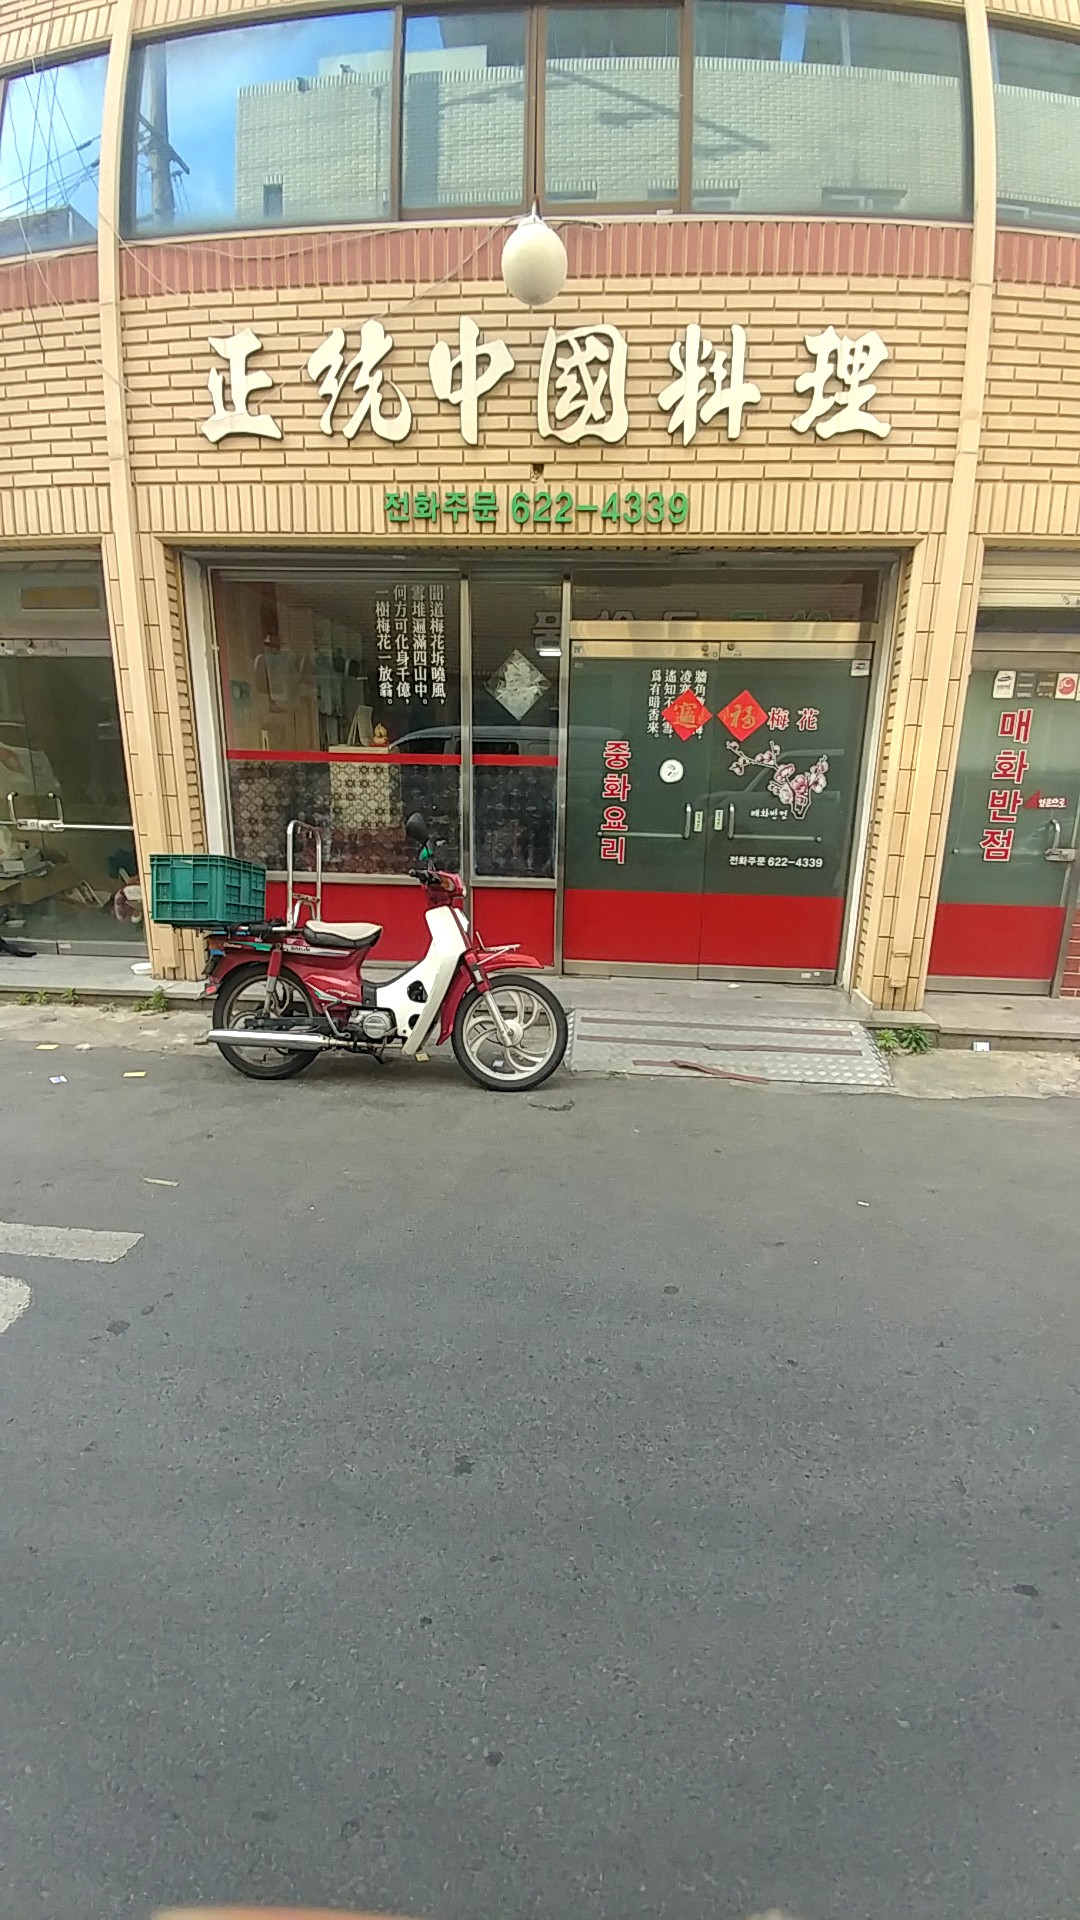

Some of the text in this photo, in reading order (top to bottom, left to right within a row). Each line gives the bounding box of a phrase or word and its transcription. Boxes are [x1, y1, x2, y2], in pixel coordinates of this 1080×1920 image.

[200, 314, 893, 446] 正統中國料理
[384, 490, 690, 525] 전화주문 622-4339
[729, 703, 757, 730] 福
[767, 706, 820, 732] 梅花
[600, 740, 632, 865] 중화요리
[979, 708, 1034, 862] 매화반점
[728, 855, 824, 868] 전화주문 622-4339
